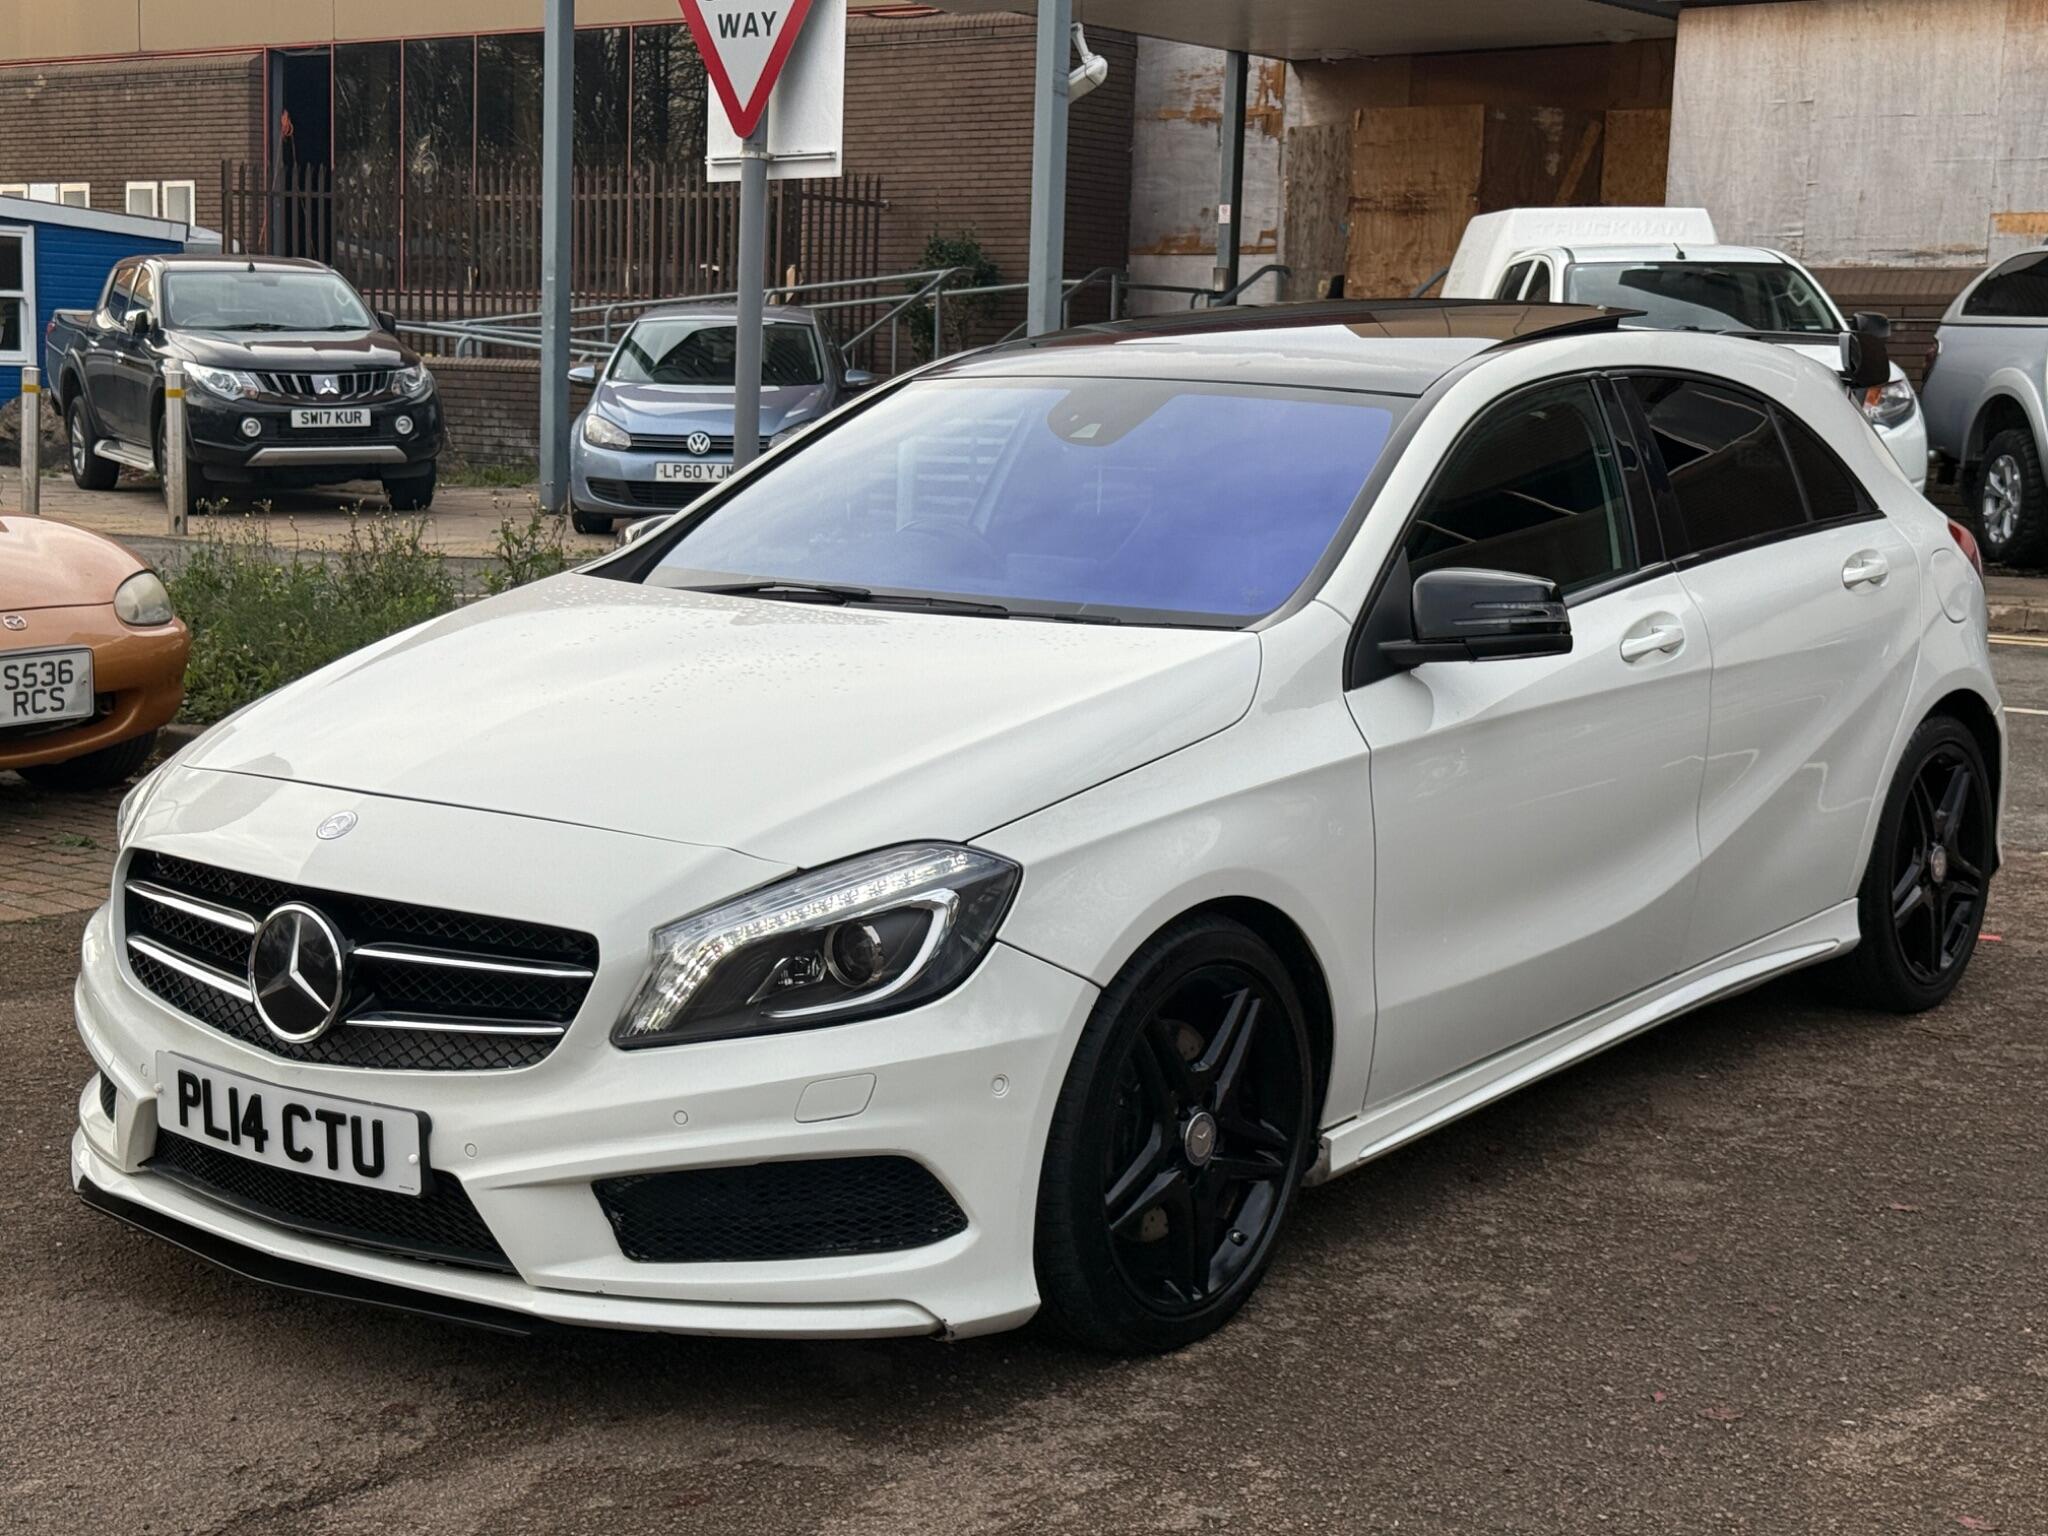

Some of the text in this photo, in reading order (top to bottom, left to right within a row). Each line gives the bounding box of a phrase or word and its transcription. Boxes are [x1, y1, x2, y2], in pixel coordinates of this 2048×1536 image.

[717, 11, 777, 38] WAY
[1535, 220, 1688, 238] TRUCKMAN
[301, 411, 362, 425] SW17 KUR
[663, 464, 702, 479] LP60
[4, 659, 73, 690] S536
[13, 687, 65, 716] RCS
[178, 1069, 385, 1178] PL14 CTU
